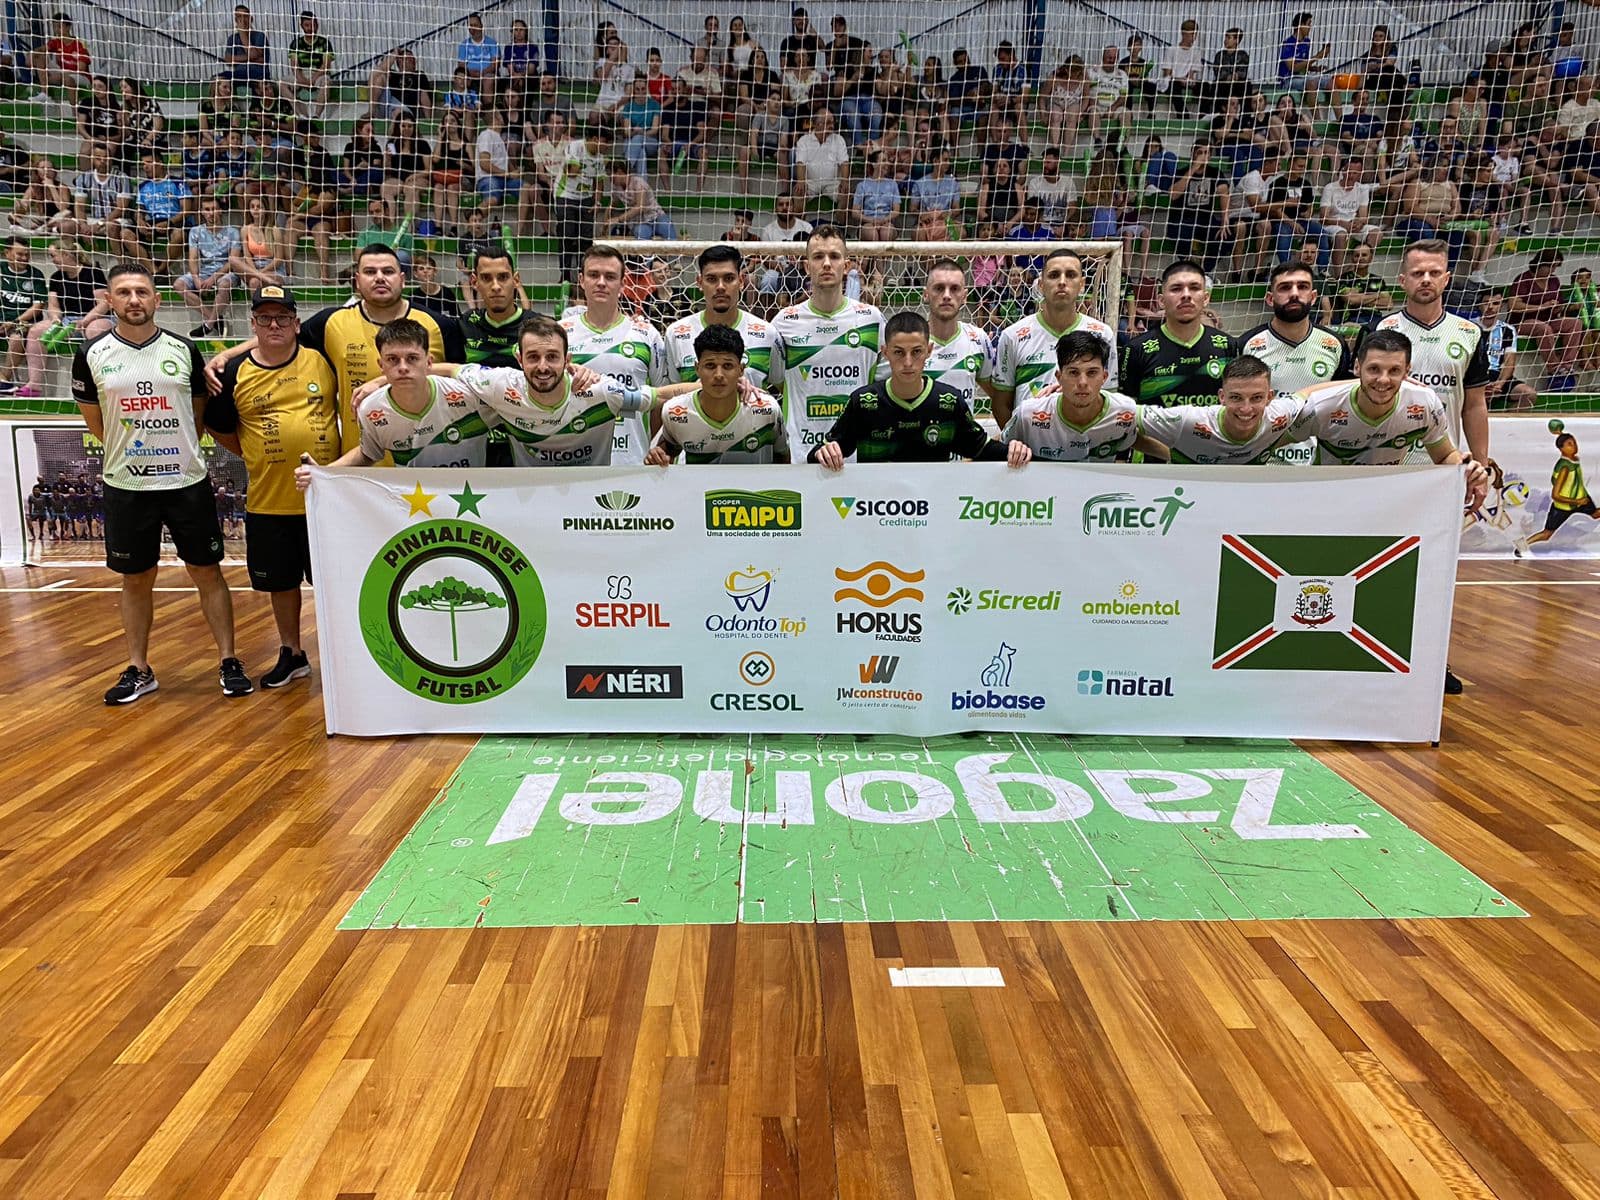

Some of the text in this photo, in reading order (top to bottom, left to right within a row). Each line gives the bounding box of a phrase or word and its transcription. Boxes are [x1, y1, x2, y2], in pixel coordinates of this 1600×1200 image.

[812, 366, 859, 378] SICOOB
[120, 396, 172, 412] SERPIL
[134, 418, 180, 429] SICOOB
[125, 445, 180, 457] tecnicon
[540, 445, 593, 462] SICOOB
[126, 464, 180, 476] WEBER
[712, 506, 795, 527] ITAIPU
[856, 500, 929, 516] SICOOB
[959, 496, 1054, 525] Zagonel
[1082, 493, 1156, 536] FMEC
[562, 518, 675, 530] PINHALZINHO
[879, 518, 928, 528] Creditaipu
[772, 530, 802, 538] pessoas
[383, 526, 528, 577] PINHALENSE
[976, 590, 1062, 610] Sicredi
[1082, 599, 1180, 615] ambiental
[575, 603, 670, 628] SERPIL
[837, 612, 922, 634] HORUS
[705, 614, 806, 637] Odonto Top
[875, 633, 921, 643] FACULDADES
[416, 676, 503, 699] FUTSAL
[607, 668, 671, 693] NÉRI
[1106, 676, 1174, 696] natal
[710, 693, 804, 711] CRESOL
[836, 687, 923, 701] JWconstrução
[951, 690, 1046, 710] biobase
[724, 746, 942, 768] Tecnologia
[485, 752, 1371, 847] Zagonel
